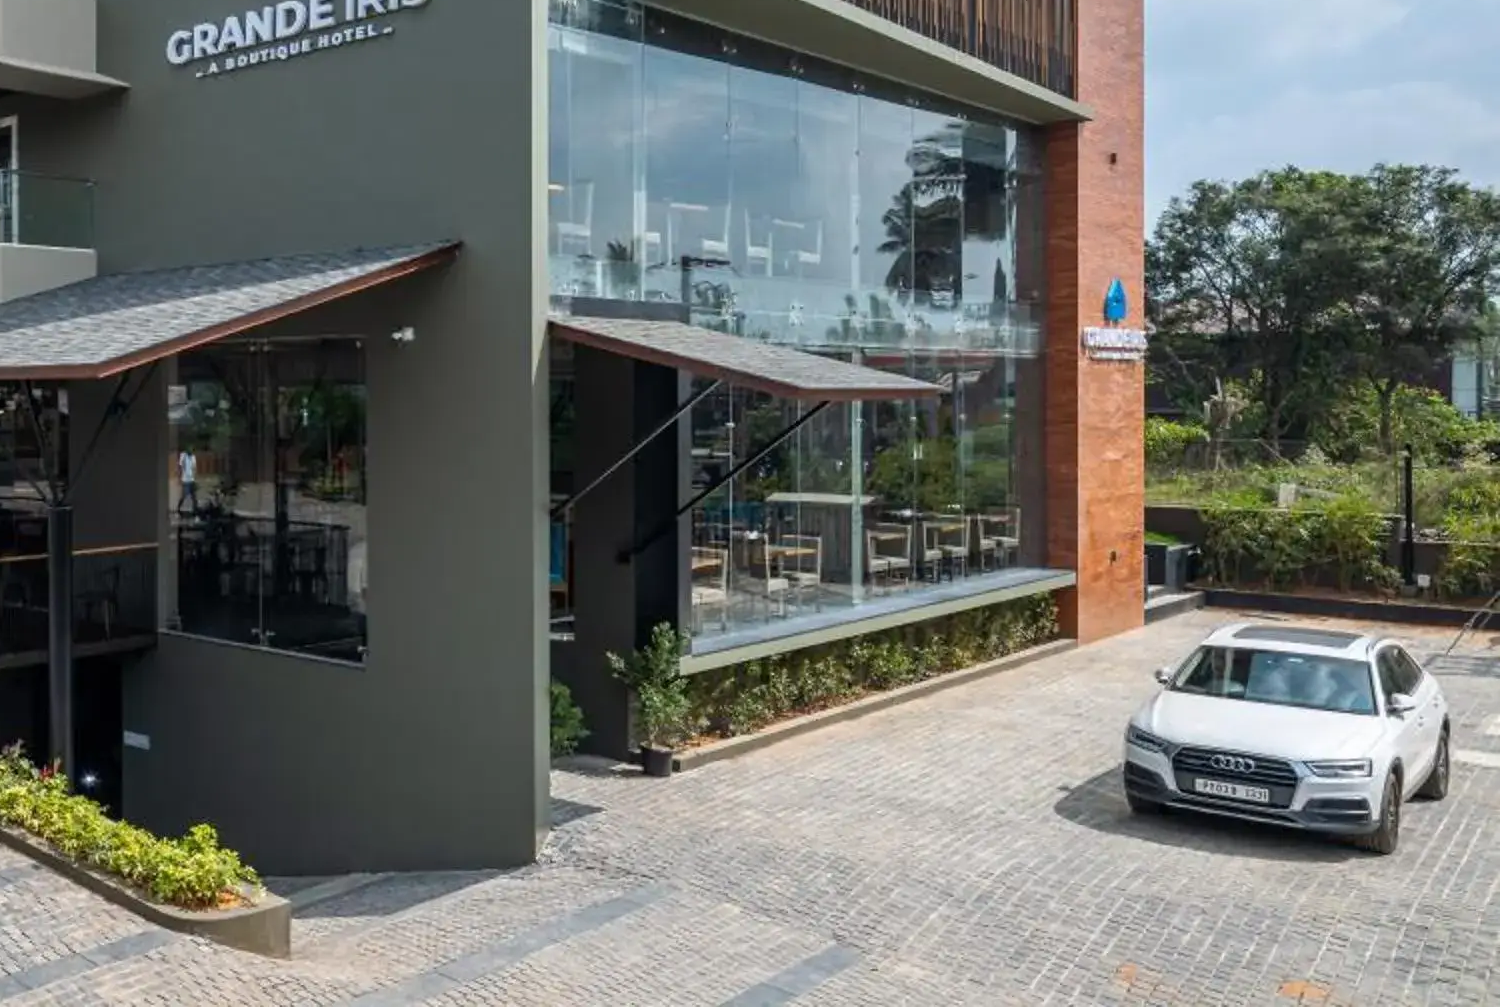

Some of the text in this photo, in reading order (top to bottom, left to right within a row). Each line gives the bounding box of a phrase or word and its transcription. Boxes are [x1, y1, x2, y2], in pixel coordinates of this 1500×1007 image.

[207, 23, 378, 74] A BOUTIQUE HOTEL
